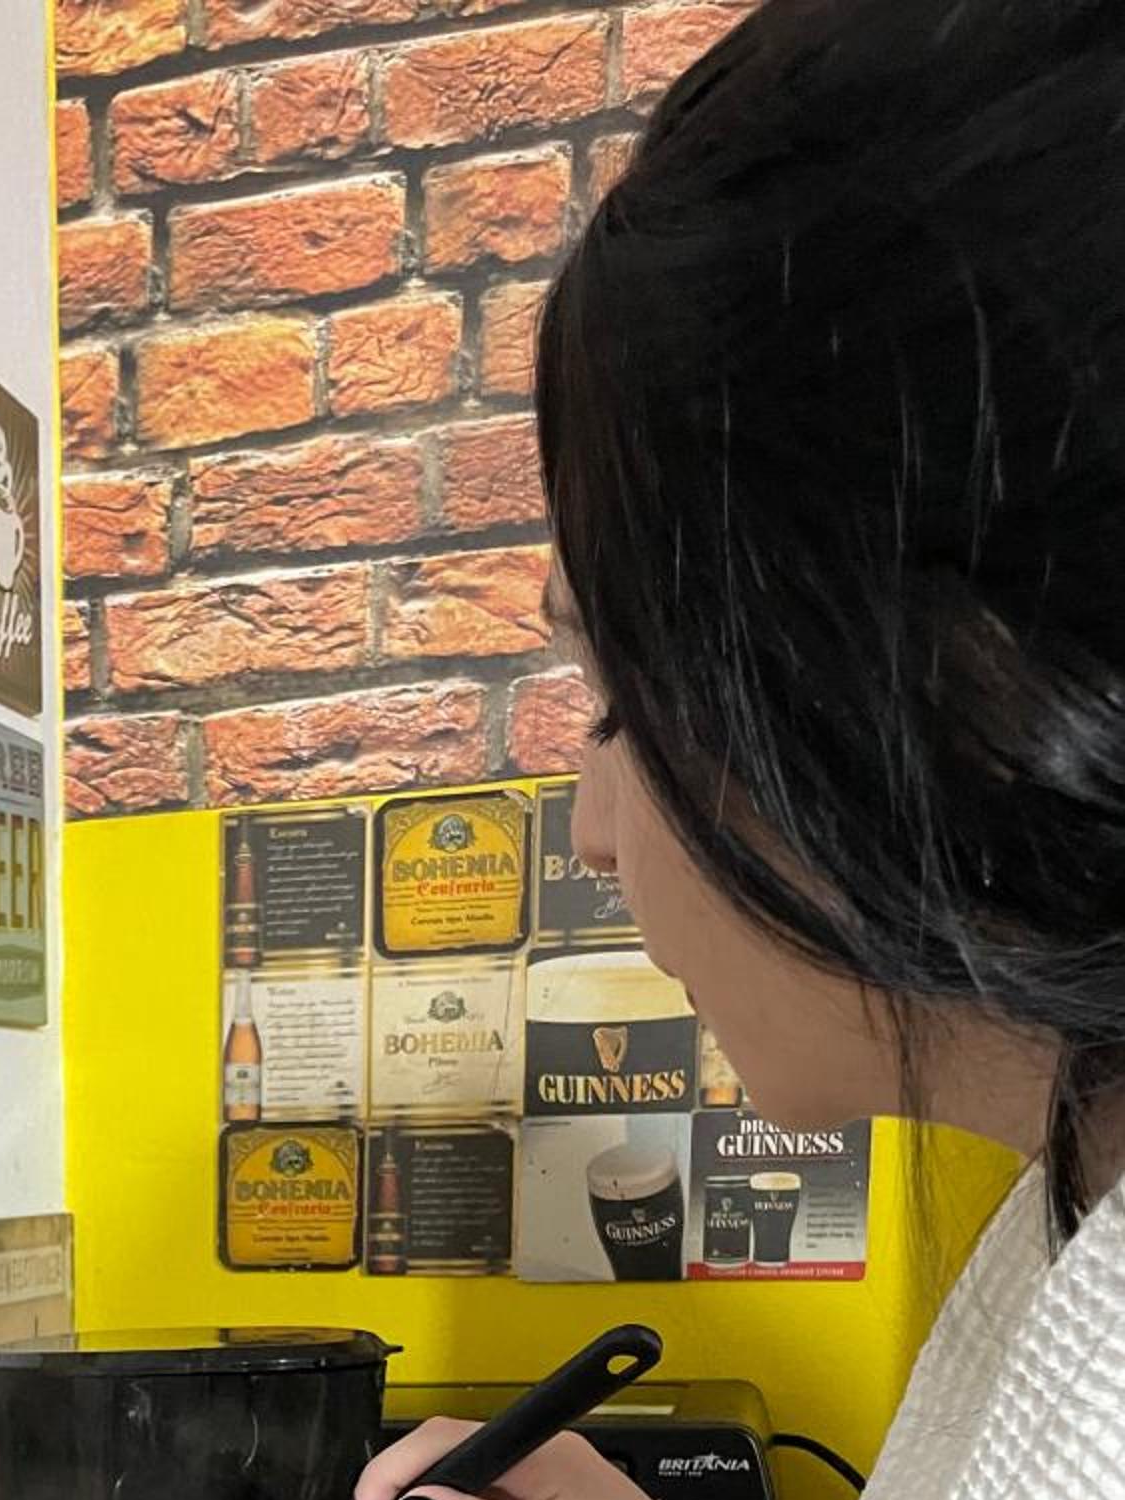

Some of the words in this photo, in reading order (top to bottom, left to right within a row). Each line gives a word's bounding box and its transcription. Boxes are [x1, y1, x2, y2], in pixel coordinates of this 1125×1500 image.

[392, 852, 516, 882] BOHEMIA
[384, 1029, 503, 1055] BOHEMIA
[538, 1068, 685, 1104] GUINNESS
[717, 1132, 844, 1156] GUINNESS
[235, 1179, 351, 1201] BOHEMIA
